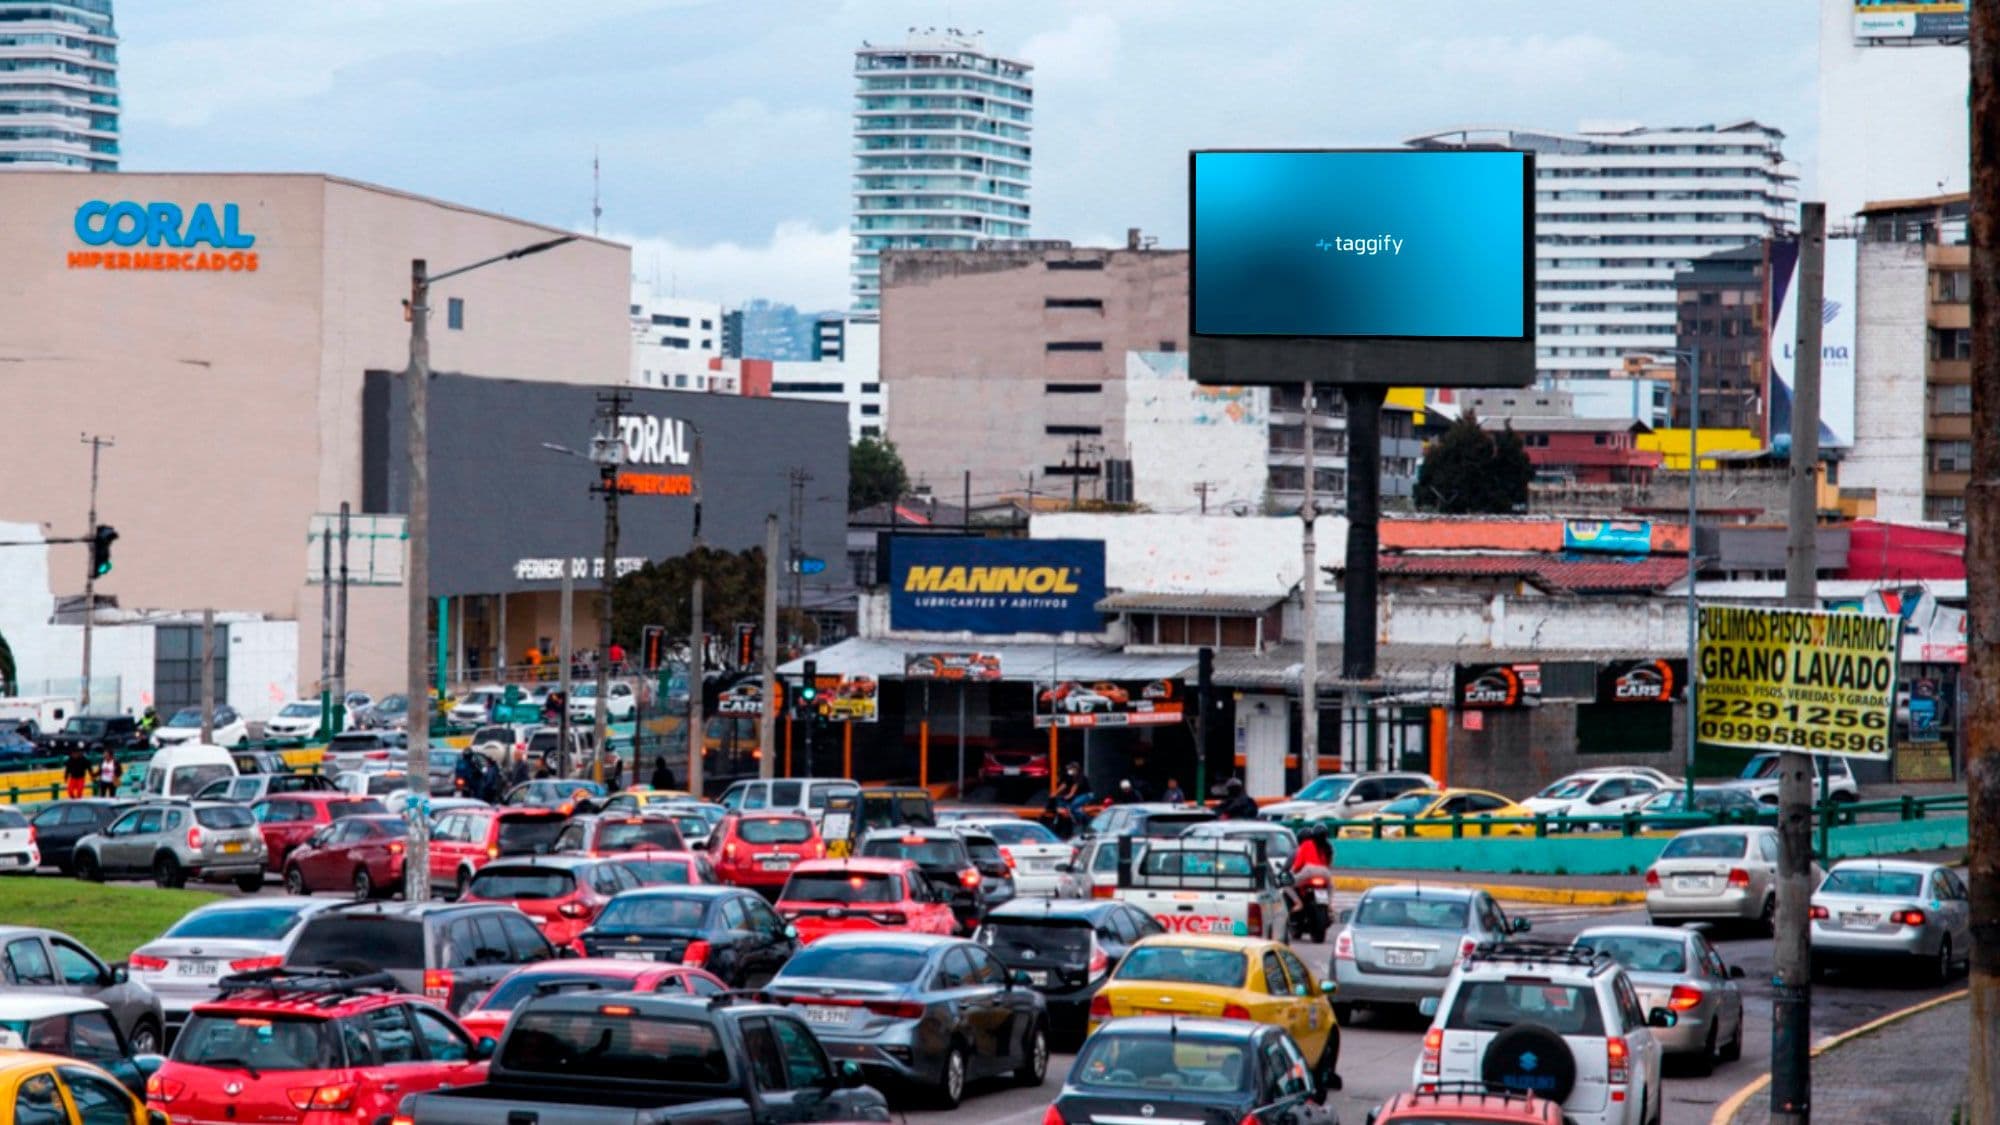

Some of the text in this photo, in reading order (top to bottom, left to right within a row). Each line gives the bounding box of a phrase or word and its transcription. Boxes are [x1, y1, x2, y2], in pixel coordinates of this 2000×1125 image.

[74, 200, 256, 249] CORAL
[1335, 234, 1404, 255] taggify
[67, 251, 258, 272] HIPERMERCADOS
[904, 565, 1079, 593] MANNOL
[914, 597, 1069, 609] LUBRICANTES Y ADITIVOS
[1700, 607, 1767, 642] PULIMOS
[1770, 610, 1813, 645] PISOS
[1827, 614, 1895, 653] MARMOL
[1701, 645, 1787, 683] GRANO
[1793, 649, 1891, 692] LAVADO
[1788, 687, 1836, 704] VEREDAS
[1847, 694, 1891, 708] GRADAS
[1704, 699, 1887, 730] 2291256
[1702, 719, 1886, 753] 0999586596
